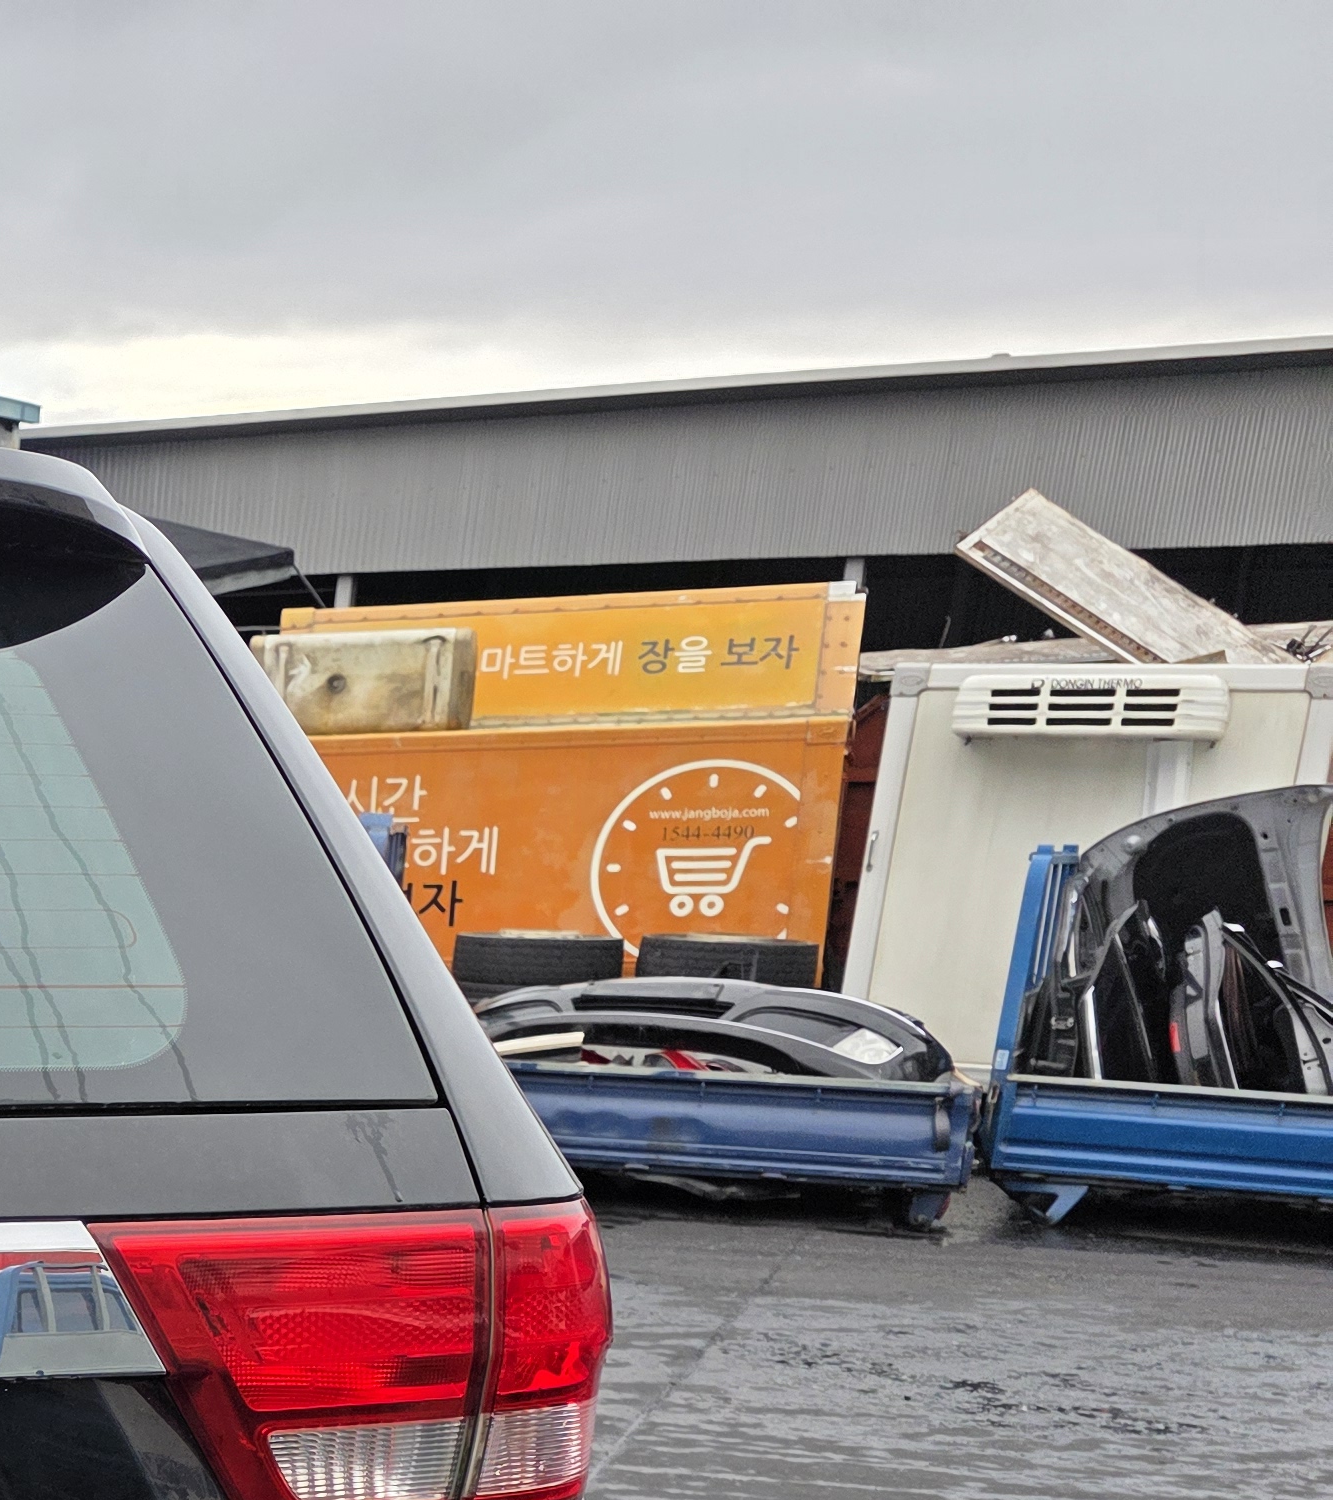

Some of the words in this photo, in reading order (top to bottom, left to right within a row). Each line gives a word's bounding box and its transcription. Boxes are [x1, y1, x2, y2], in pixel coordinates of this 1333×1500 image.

[480, 640, 623, 680] 마트하게
[638, 636, 712, 674] 장을
[720, 635, 799, 669] 보자
[649, 807, 770, 821] www.jangboja.com
[662, 825, 755, 841] 1544-4490
[405, 826, 498, 875] 하게
